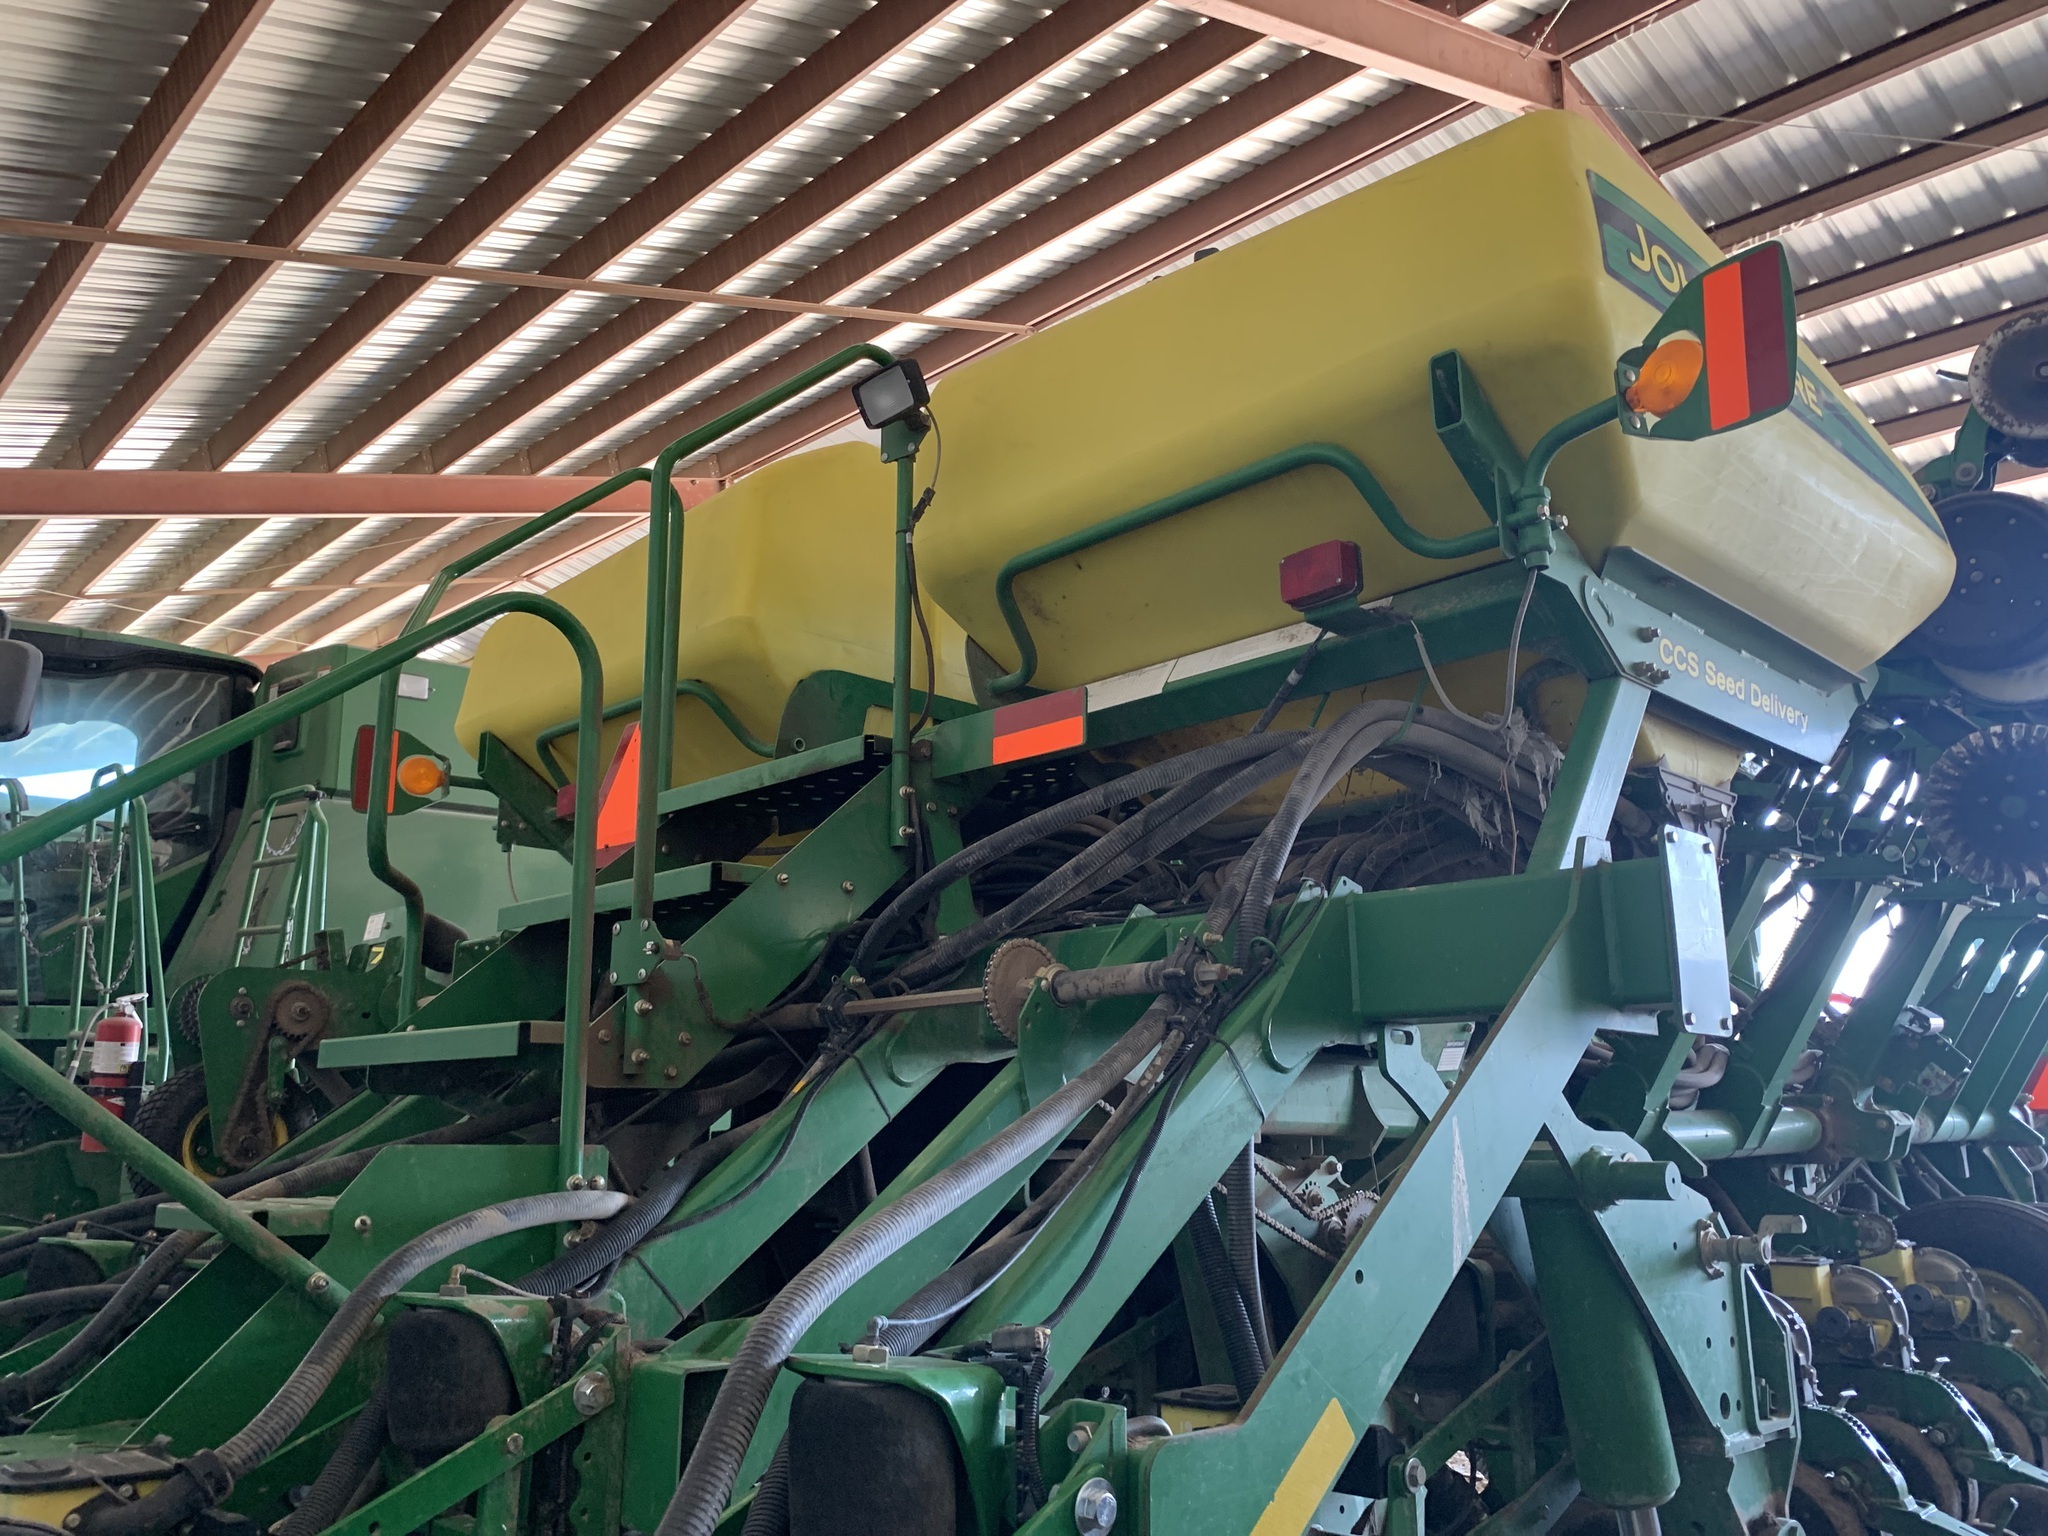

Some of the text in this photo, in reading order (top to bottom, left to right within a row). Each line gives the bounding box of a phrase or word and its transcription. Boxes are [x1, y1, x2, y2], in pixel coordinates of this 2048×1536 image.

[1660, 638, 1808, 733] CCS Seed Delivery
